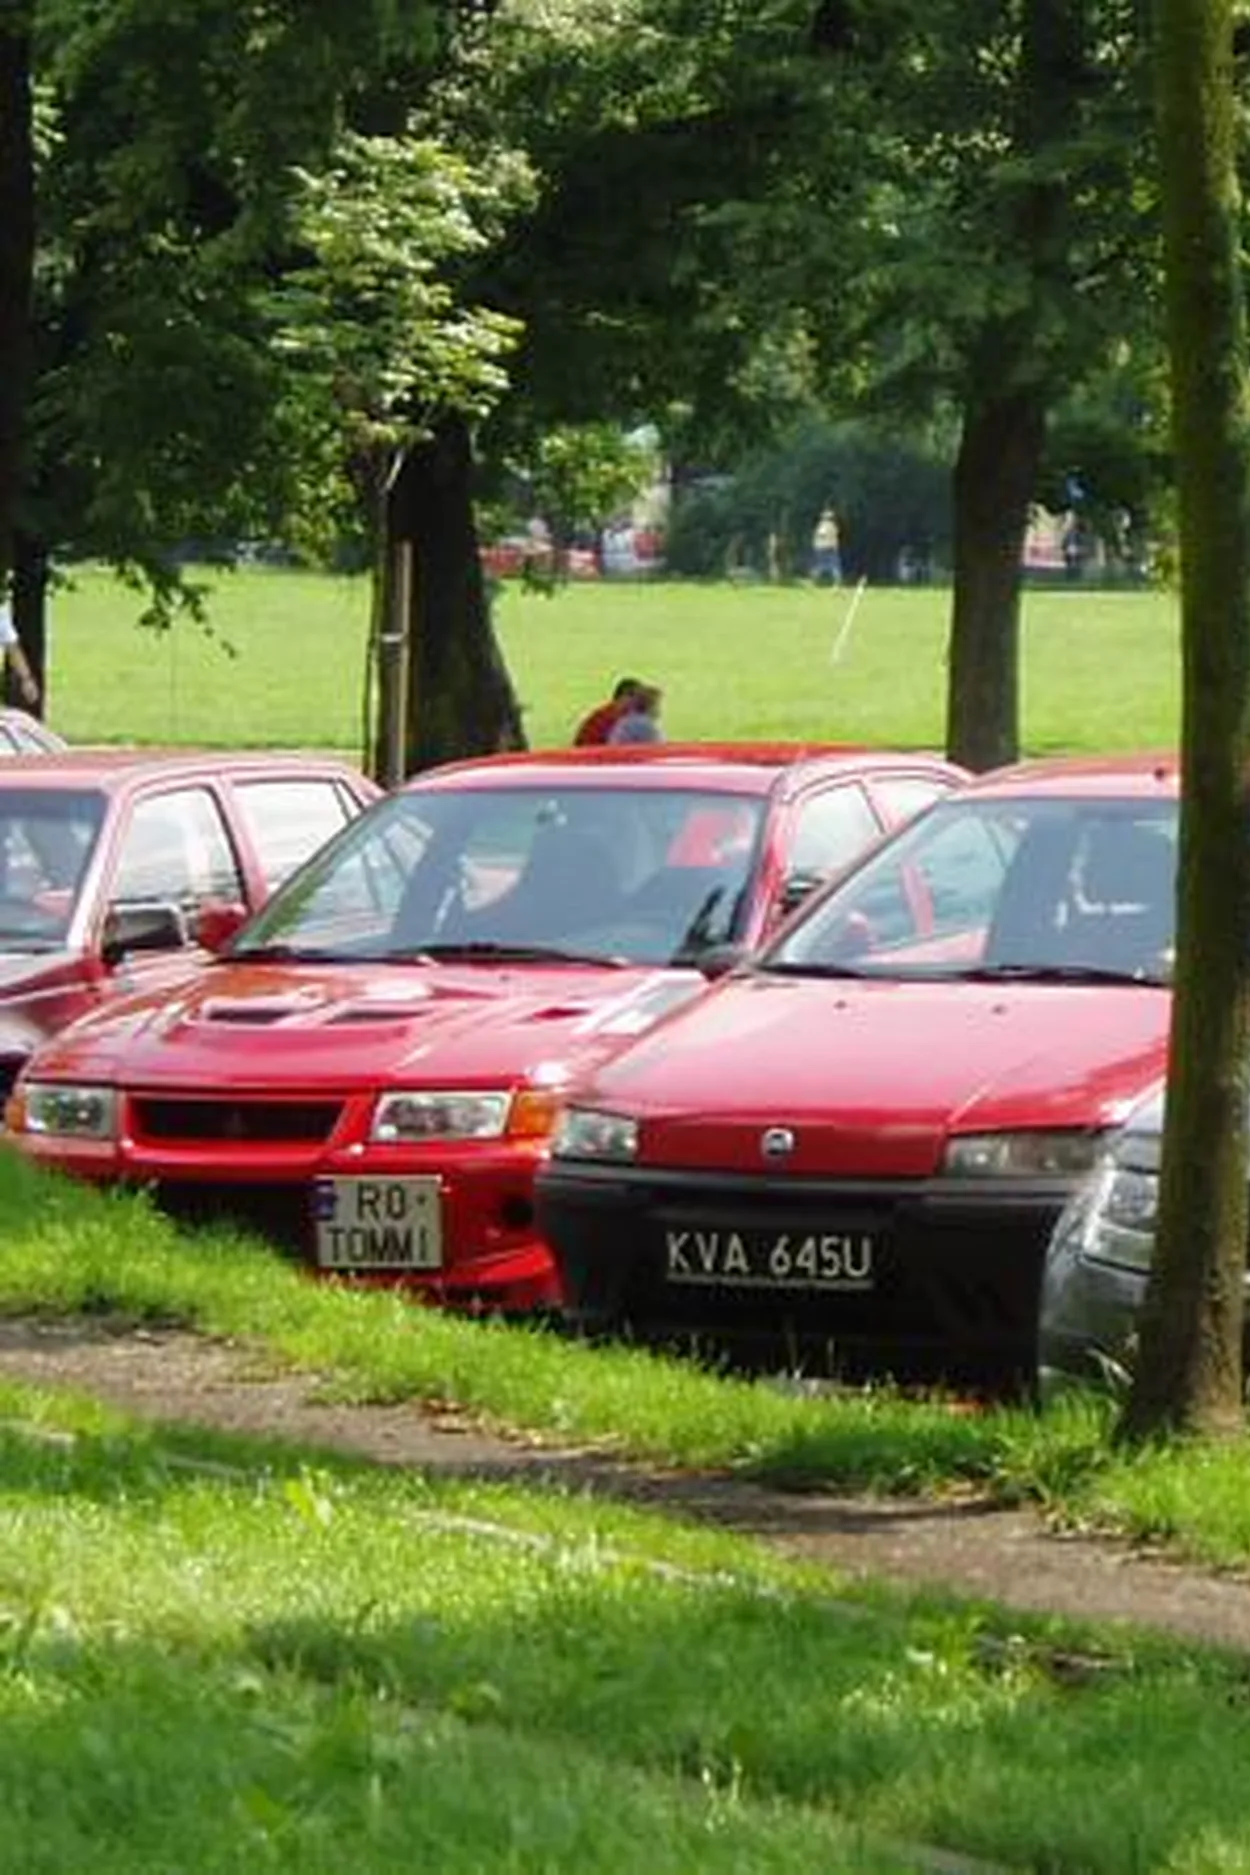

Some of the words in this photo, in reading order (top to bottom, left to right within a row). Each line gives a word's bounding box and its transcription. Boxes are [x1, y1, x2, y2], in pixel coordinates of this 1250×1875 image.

[327, 1226, 427, 1262] TOMMI
[667, 1232, 749, 1272] KVA
[769, 1234, 871, 1277] 645U
